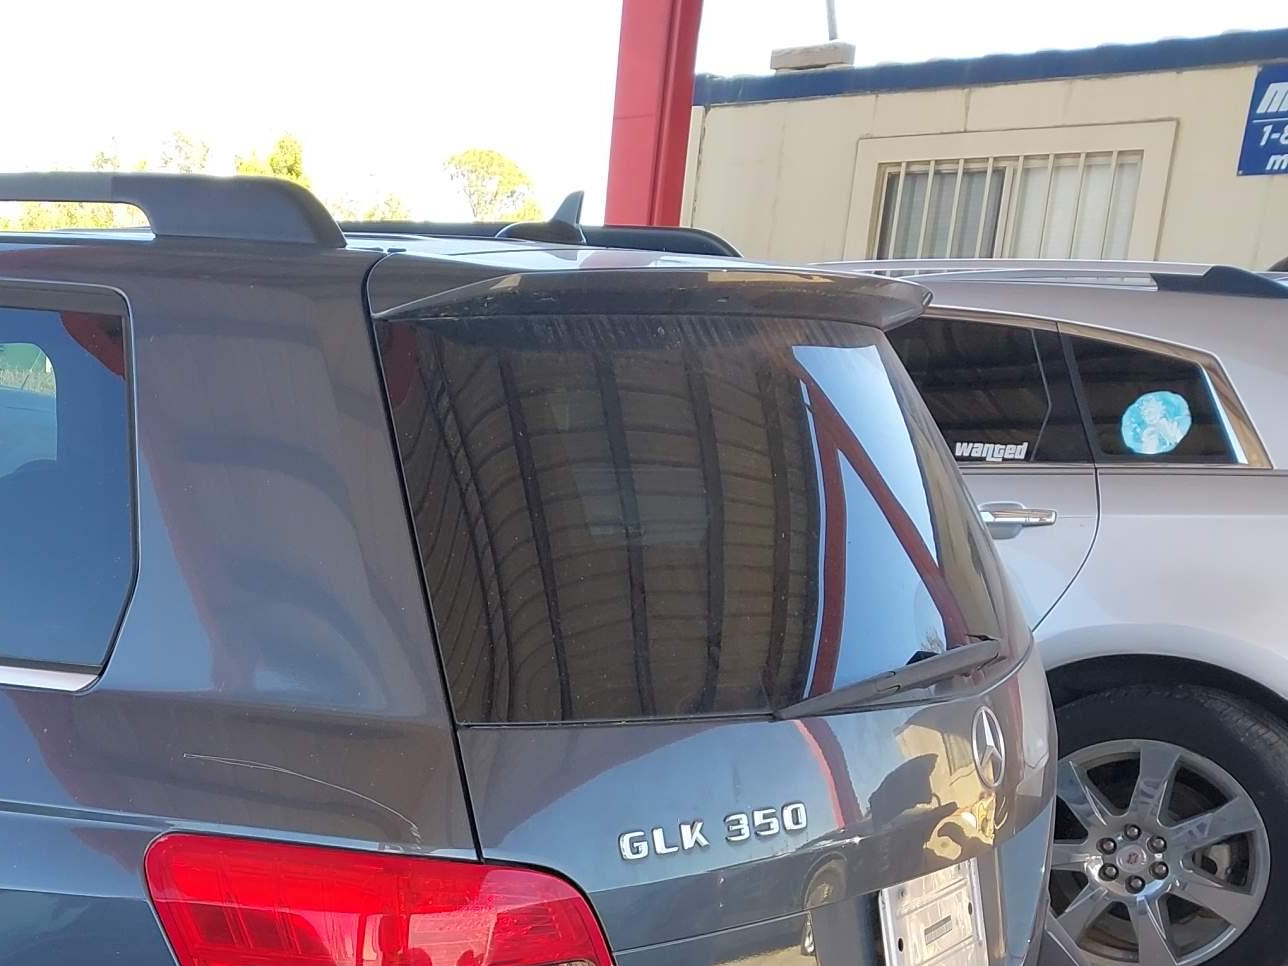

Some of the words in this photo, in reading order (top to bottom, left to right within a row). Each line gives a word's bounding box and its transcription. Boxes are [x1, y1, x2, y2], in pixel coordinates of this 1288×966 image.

[955, 442, 1029, 462] wanted
[618, 820, 711, 861] GLK
[723, 801, 808, 842] 350
